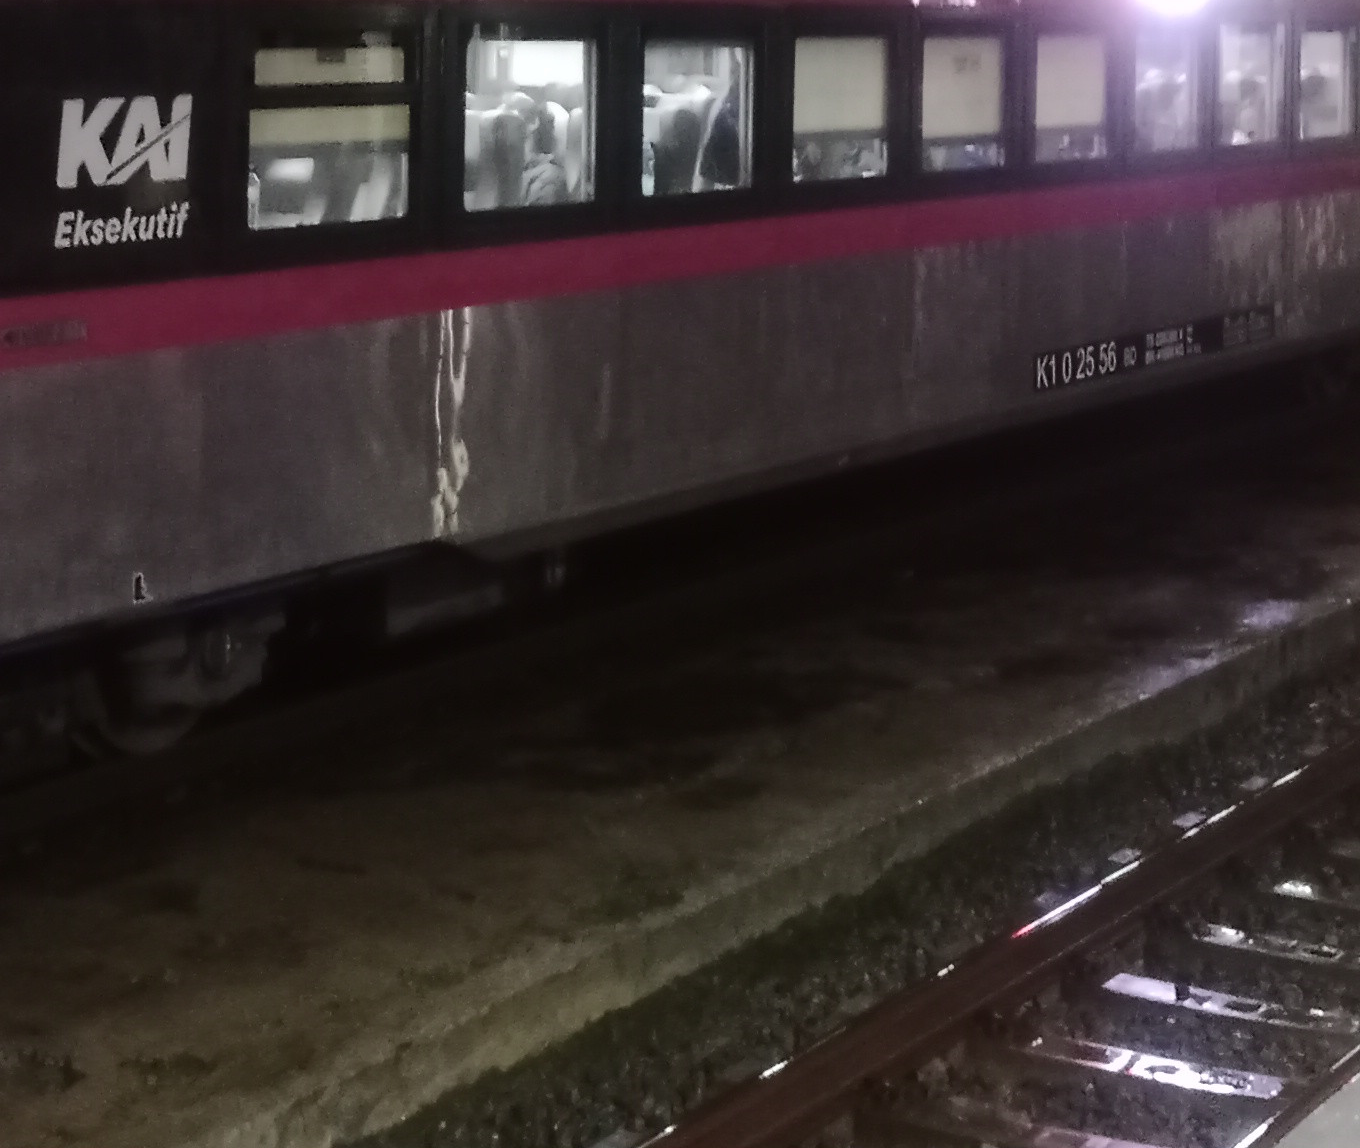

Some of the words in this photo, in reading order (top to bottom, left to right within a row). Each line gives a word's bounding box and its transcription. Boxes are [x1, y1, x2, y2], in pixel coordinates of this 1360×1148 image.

[56, 93, 193, 189] KAI
[54, 201, 190, 249] Eksekutif
[1036, 352, 1057, 389] K1
[1062, 351, 1072, 384] 0
[1075, 345, 1095, 380] 25
[1098, 341, 1117, 375] 56
